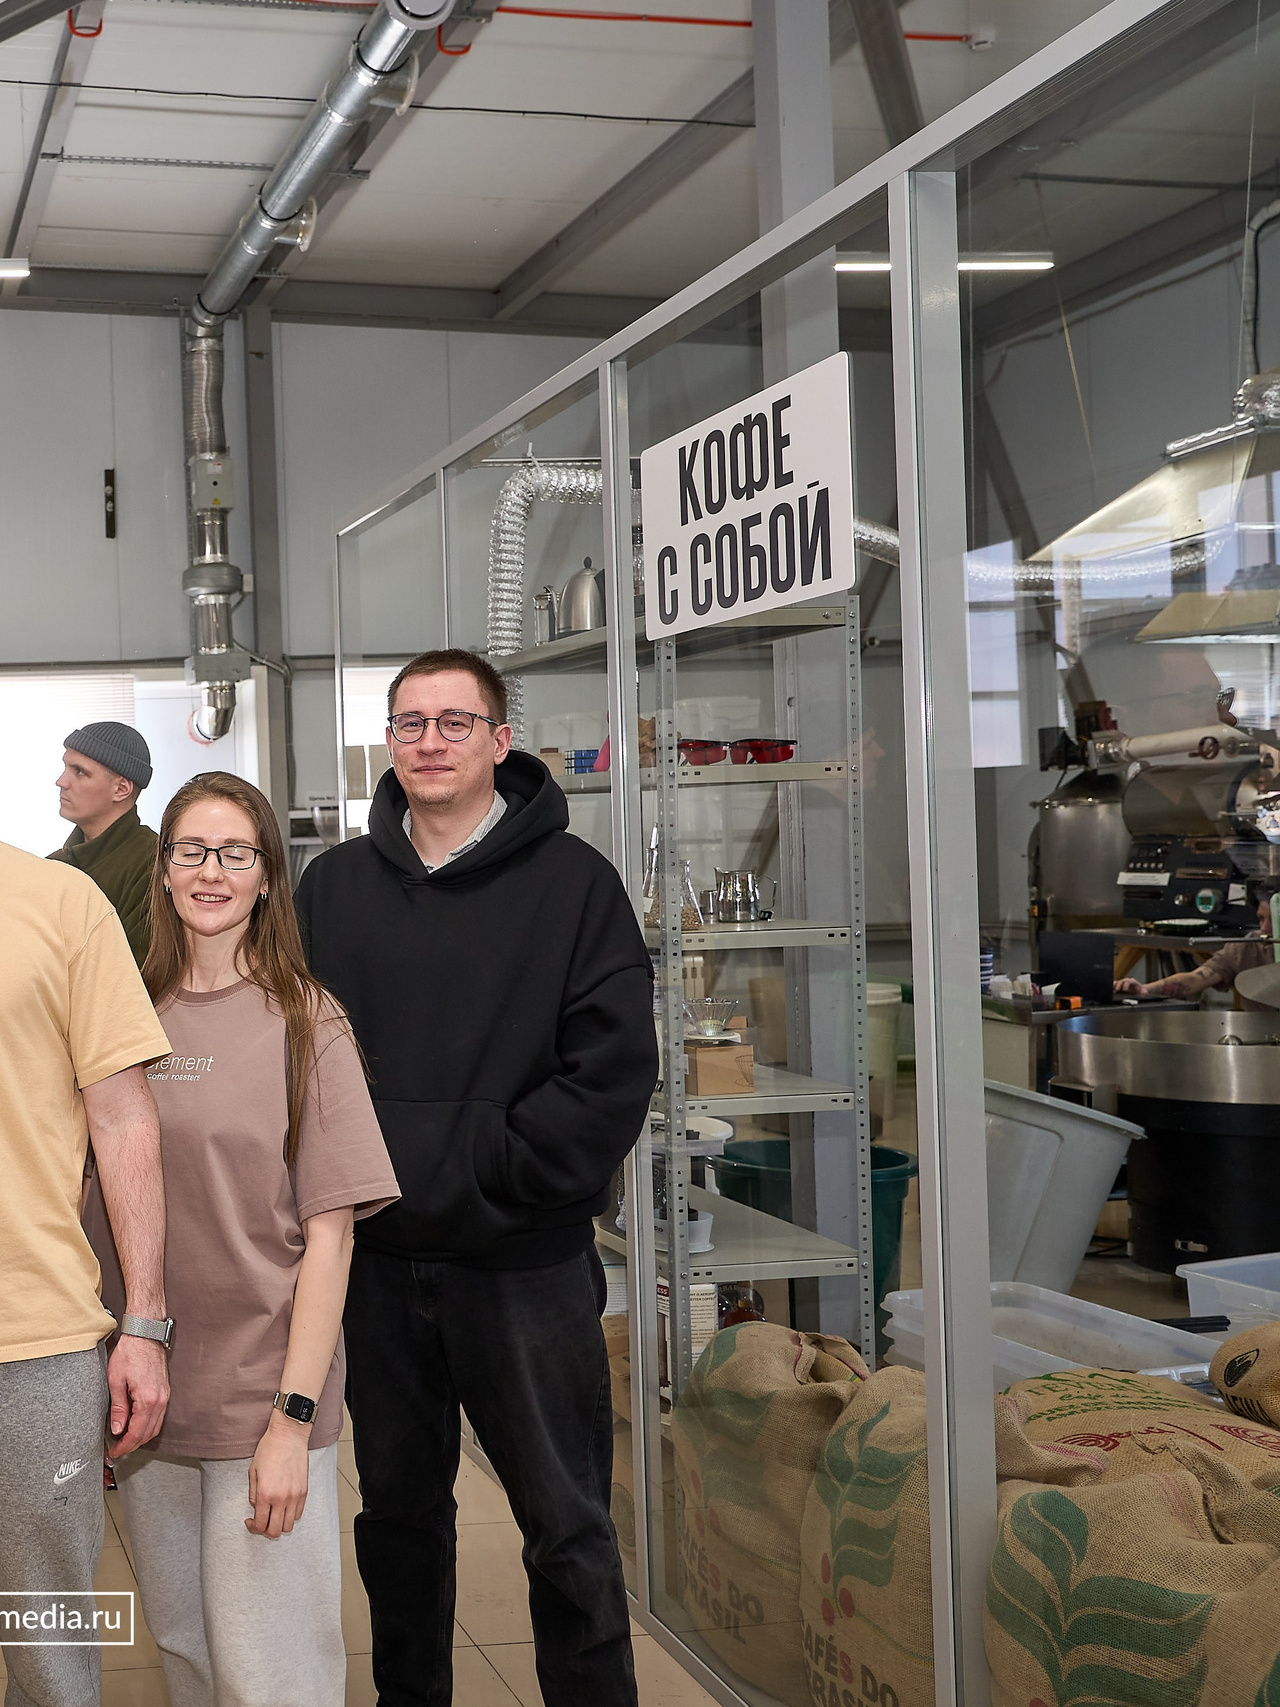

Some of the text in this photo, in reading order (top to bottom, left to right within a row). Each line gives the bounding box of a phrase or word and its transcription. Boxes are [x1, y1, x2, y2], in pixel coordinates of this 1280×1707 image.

[678, 394, 794, 527] КОФЕ
[657, 480, 832, 625] С СОБОЙ
[58, 1458, 81, 1477] NIKE
[687, 1568, 747, 1645] RASIL
[727, 1579, 764, 1624] DO
[803, 1622, 854, 1684] AFÉS
